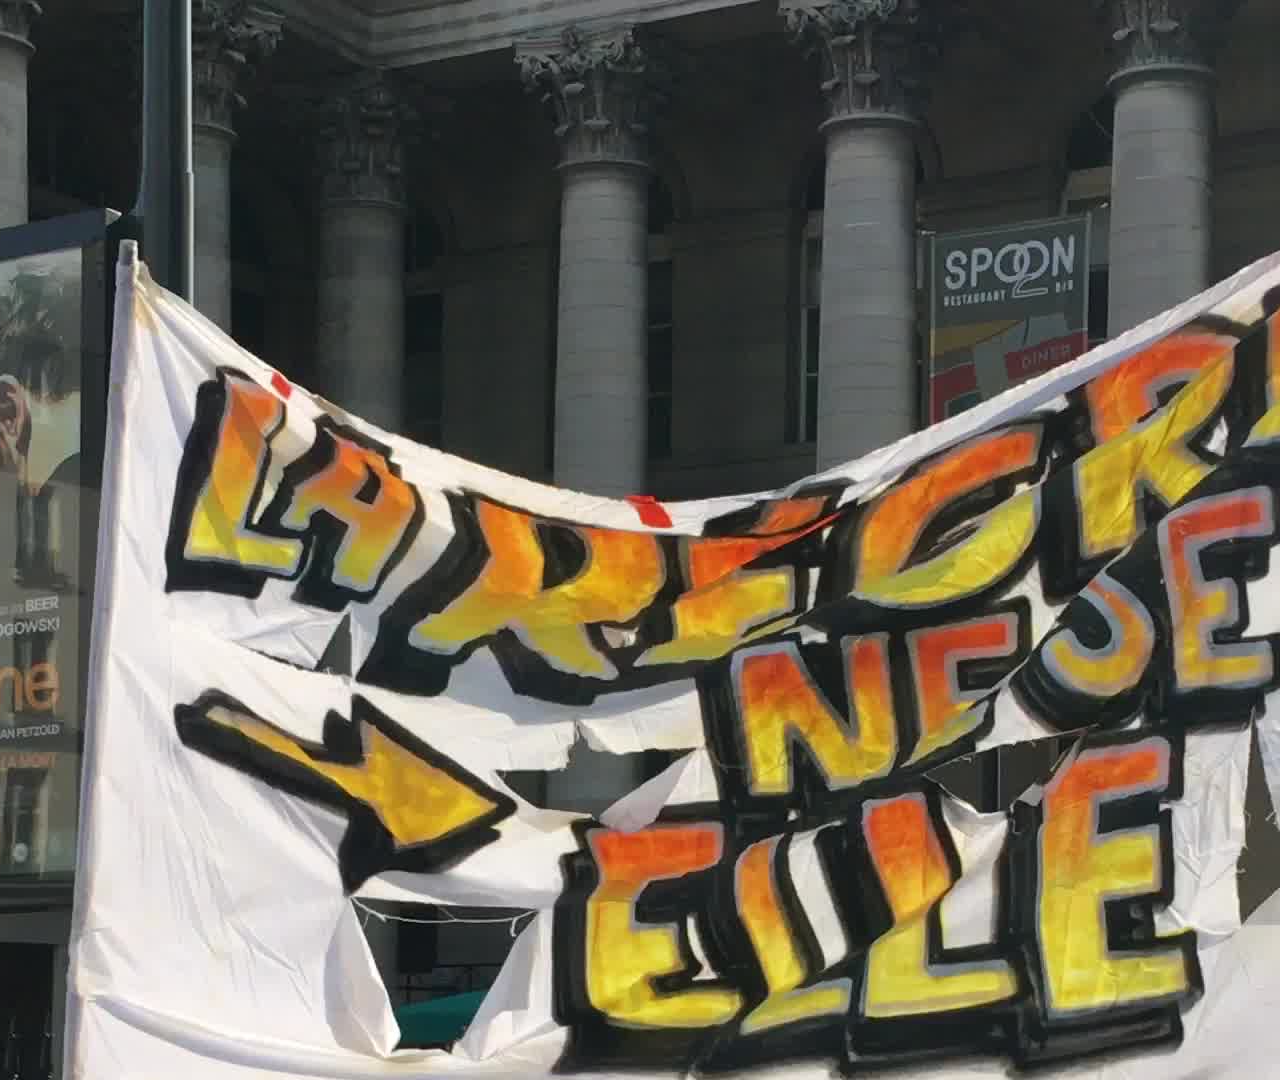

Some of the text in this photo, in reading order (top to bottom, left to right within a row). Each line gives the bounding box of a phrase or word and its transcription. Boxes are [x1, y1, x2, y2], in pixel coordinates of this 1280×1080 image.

[165, 366, 426, 610] LA
[25, 596, 59, 613] BEER
[700, 600, 1034, 798] NE
[553, 728, 1204, 1080] ELLE
